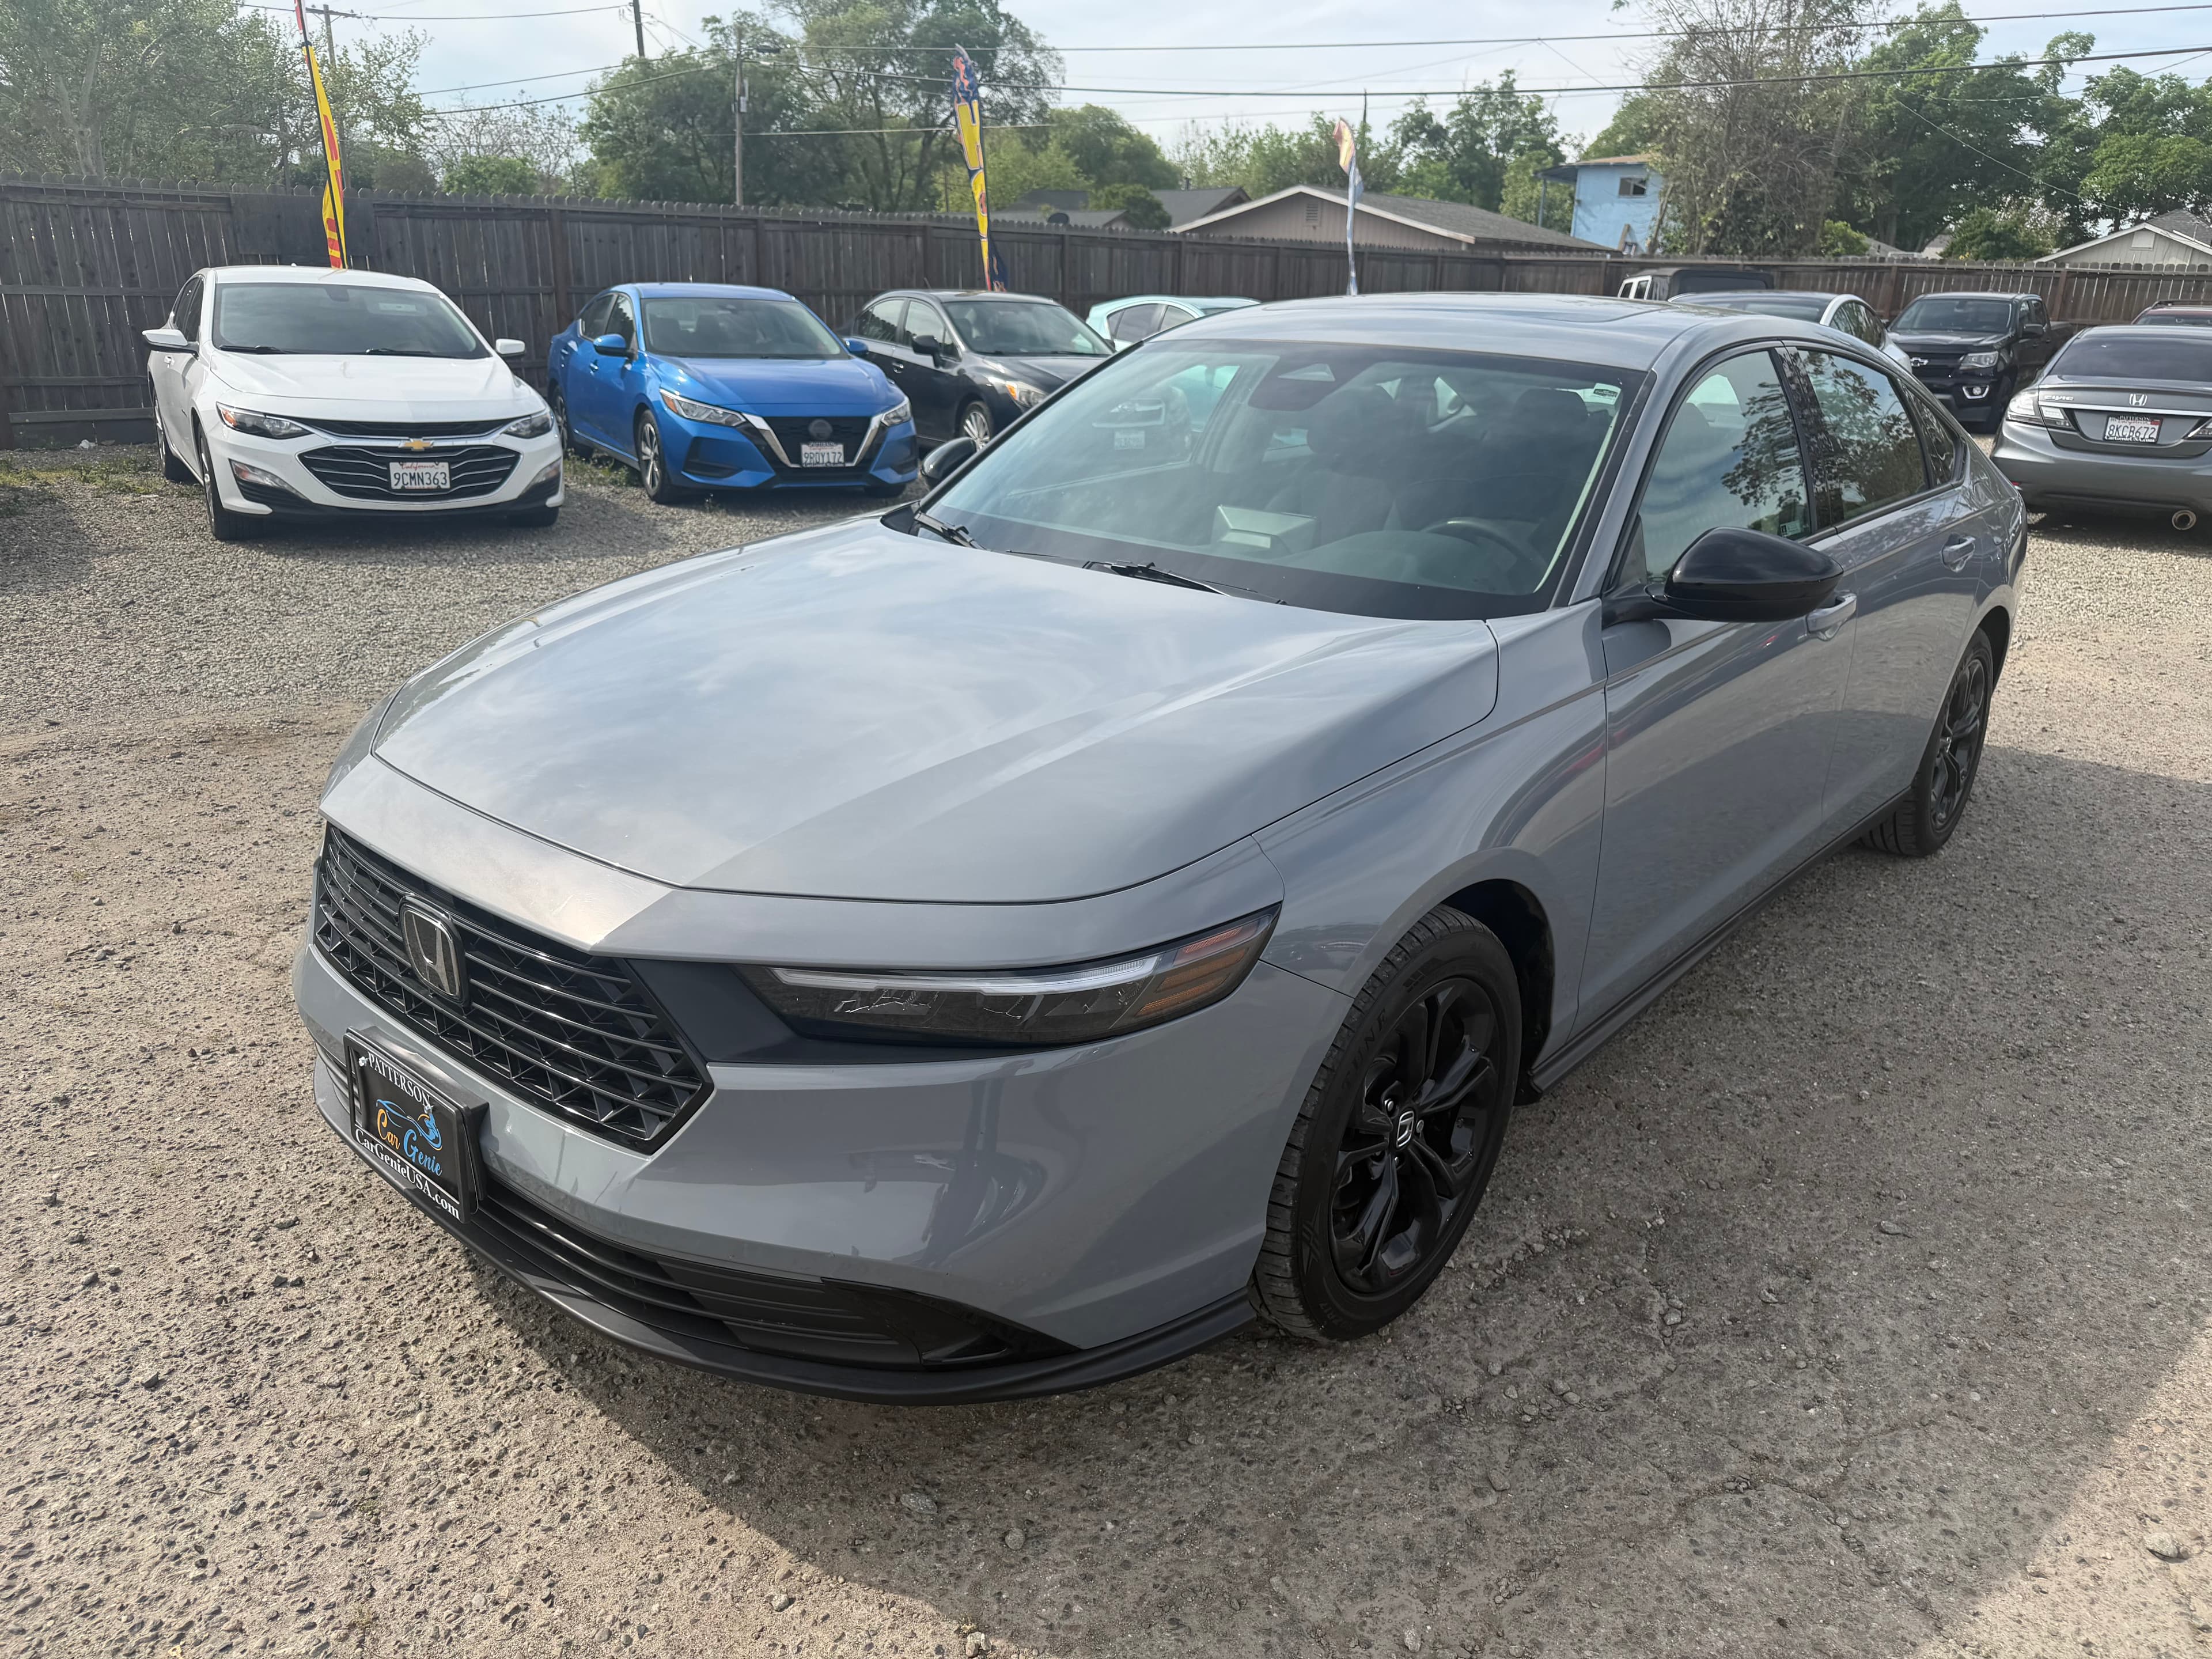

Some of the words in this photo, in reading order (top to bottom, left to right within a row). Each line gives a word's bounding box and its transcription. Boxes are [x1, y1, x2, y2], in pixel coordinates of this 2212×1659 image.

[2108, 424, 2156, 440] 8KCB672
[393, 472, 447, 487] 9CMN363
[368, 1051, 431, 1108] PATTERSON
[377, 1108, 400, 1151] Car
[403, 1128, 442, 1177] Genie
[355, 1128, 460, 1221] CarGenieUSA.com
